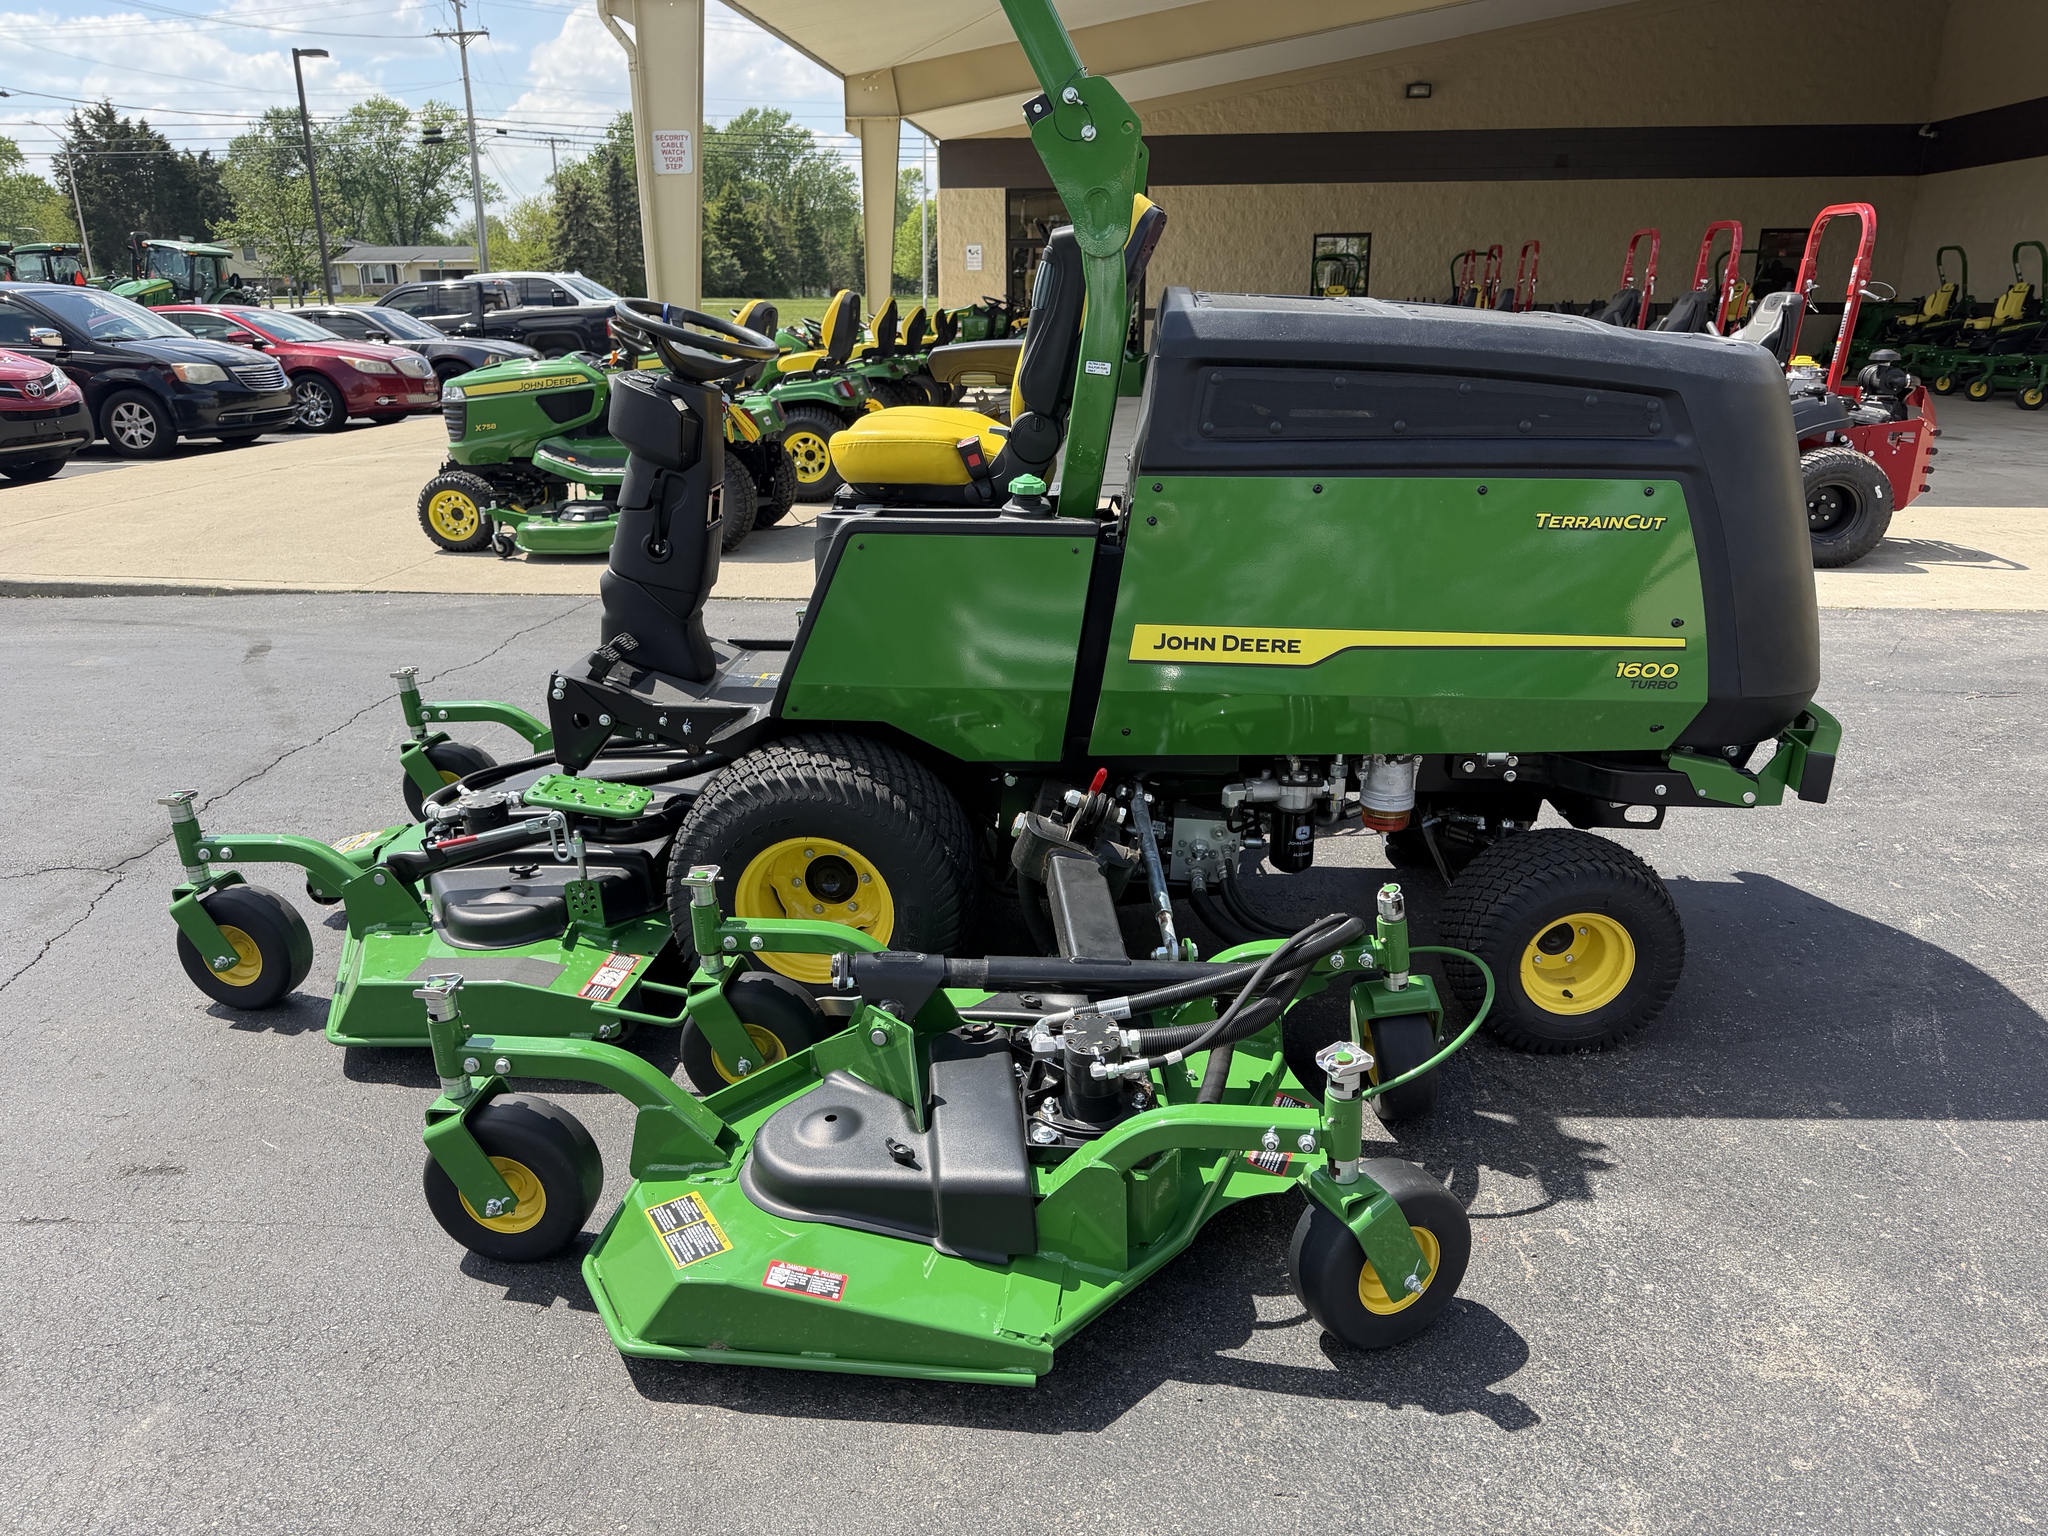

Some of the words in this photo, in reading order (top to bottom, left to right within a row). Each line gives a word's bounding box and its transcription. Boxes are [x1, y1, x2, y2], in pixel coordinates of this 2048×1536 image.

[518, 382, 544, 391] JOHN
[545, 377, 578, 387] DEERE
[1153, 633, 1216, 651] JOHN
[1222, 634, 1302, 653] DEERE
[1615, 661, 1680, 679] 1600
[1630, 680, 1678, 690] TURBO
[786, 1264, 808, 1272] DANGER
[821, 1271, 842, 1279] PELIGRO
